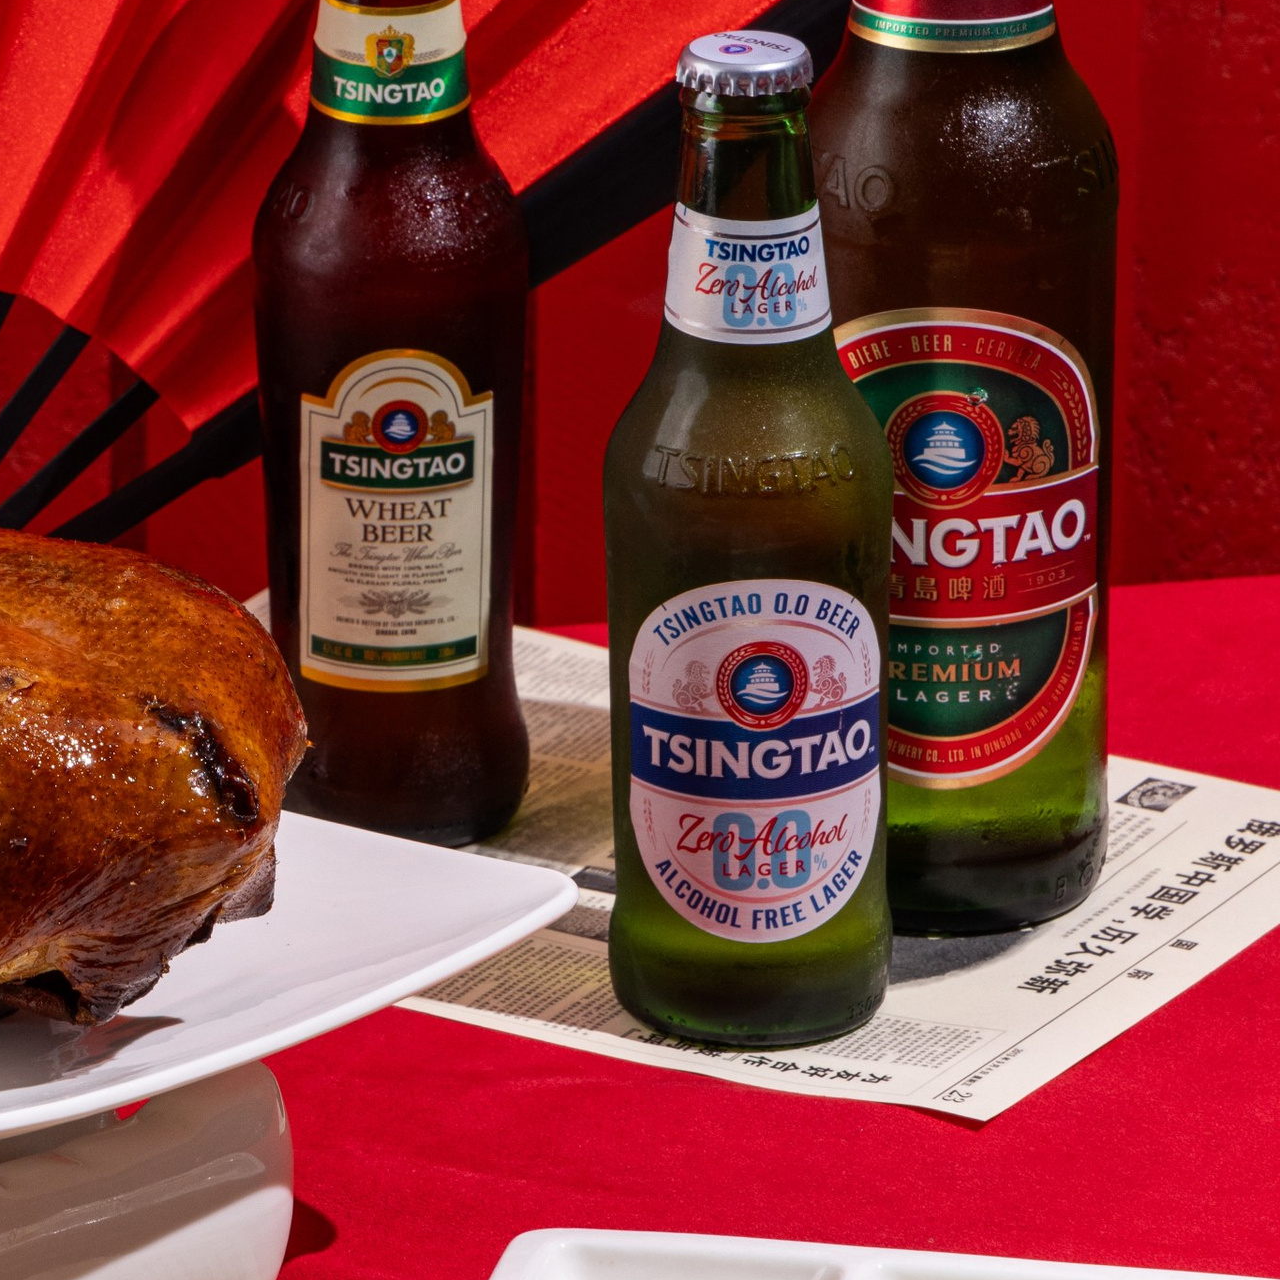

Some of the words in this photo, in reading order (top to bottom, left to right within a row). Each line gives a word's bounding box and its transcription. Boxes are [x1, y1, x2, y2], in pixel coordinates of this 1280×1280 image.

[875, 19, 929, 36] IMPORTED
[935, 27, 991, 38] PREMIUM
[996, 23, 1028, 36] LAGER
[713, 33, 792, 53] TSINGTAO
[333, 76, 445, 105] TSINGTAO
[705, 236, 810, 263] TSINGTAO
[695, 262, 740, 297] Zero
[738, 265, 818, 304] Alcohol
[730, 300, 793, 314] LAGER
[847, 339, 891, 369] BIERE
[911, 334, 952, 353] BEER
[975, 337, 1043, 370] CERVEZA
[329, 452, 466, 480] TSINGTAO
[655, 441, 854, 495] TSINGTAO
[345, 498, 452, 522] WHEAT
[362, 524, 433, 544] BEER
[891, 499, 1086, 568] NGTAO
[402, 545, 435, 562] Wheat
[1028, 569, 1066, 586] 1903
[653, 592, 762, 646] TSINGTAO
[773, 592, 809, 617] 0.0
[815, 597, 862, 640] BEER
[889, 643, 1001, 656] MPORTED
[889, 659, 1021, 683] REMIUM
[896, 689, 991, 703] LAGER
[888, 737, 922, 760] REWERY
[970, 746, 982, 759] IN
[1024, 704, 1049, 731] CHINA
[642, 719, 871, 779] TSINGTAO
[677, 813, 734, 855] Zero
[734, 813, 849, 859] Alcohol
[722, 859, 806, 878] LAGER
[655, 859, 742, 929] ALCOHOL
[752, 905, 806, 931] FREE
[811, 849, 862, 913] LAGER
[942, 1089, 973, 1103] 23
